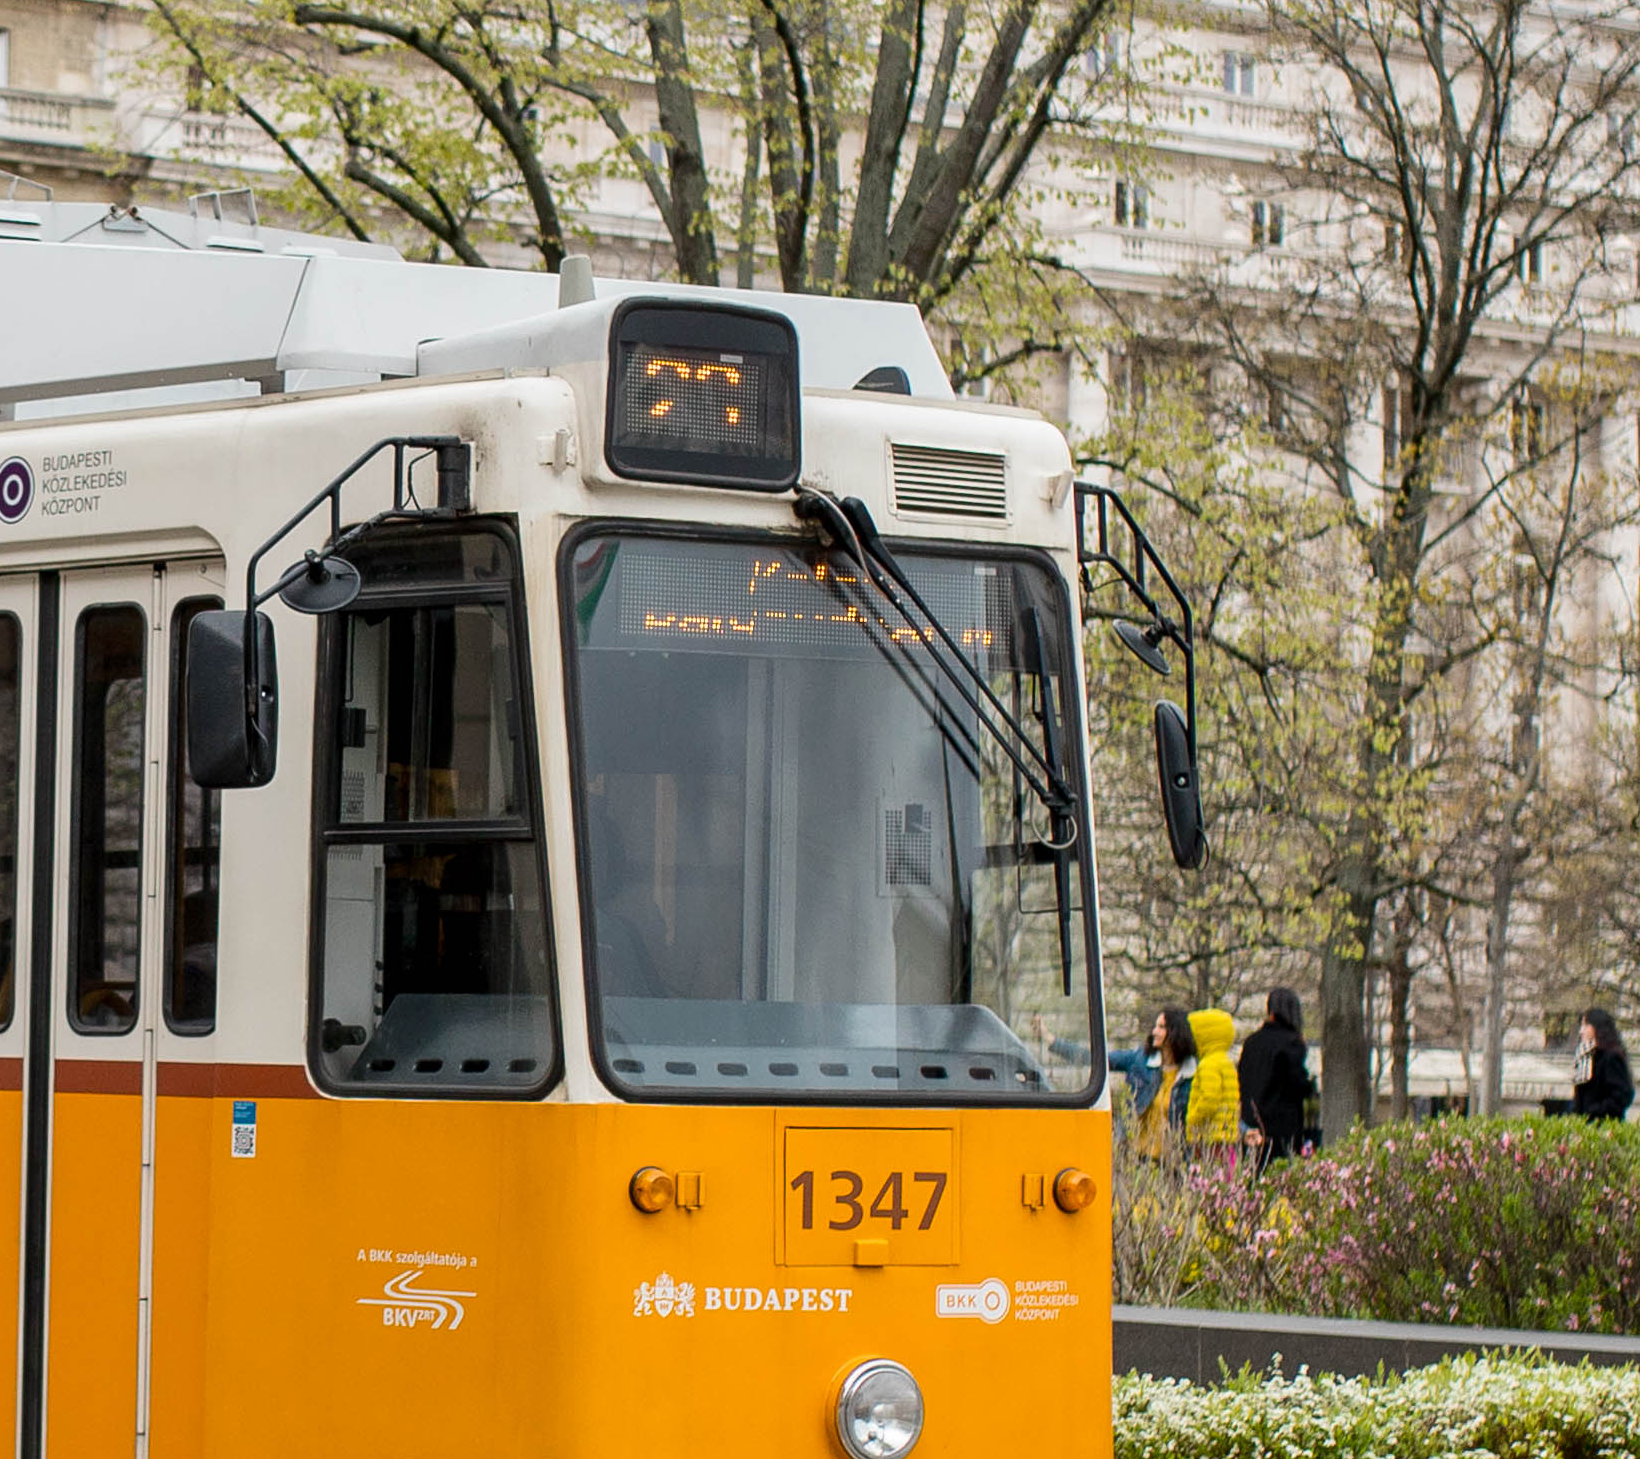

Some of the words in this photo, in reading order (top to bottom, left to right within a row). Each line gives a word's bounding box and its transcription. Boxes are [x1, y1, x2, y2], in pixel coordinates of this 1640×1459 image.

[42, 450, 112, 472] BUDAPESTI
[42, 468, 127, 494] KÖZLEKEDÉSI
[41, 495, 101, 516] KÖZPONT
[790, 1170, 948, 1231] 1347
[357, 1249, 366, 1262] A
[369, 1249, 393, 1263] BKK
[396, 1250, 467, 1269] szolgáltatója
[470, 1256, 477, 1267] a
[1015, 1280, 1067, 1292] BUDAPESTI
[704, 1288, 852, 1313] BUDAPEST
[946, 1294, 977, 1308] BKK
[383, 1308, 417, 1327] BKV
